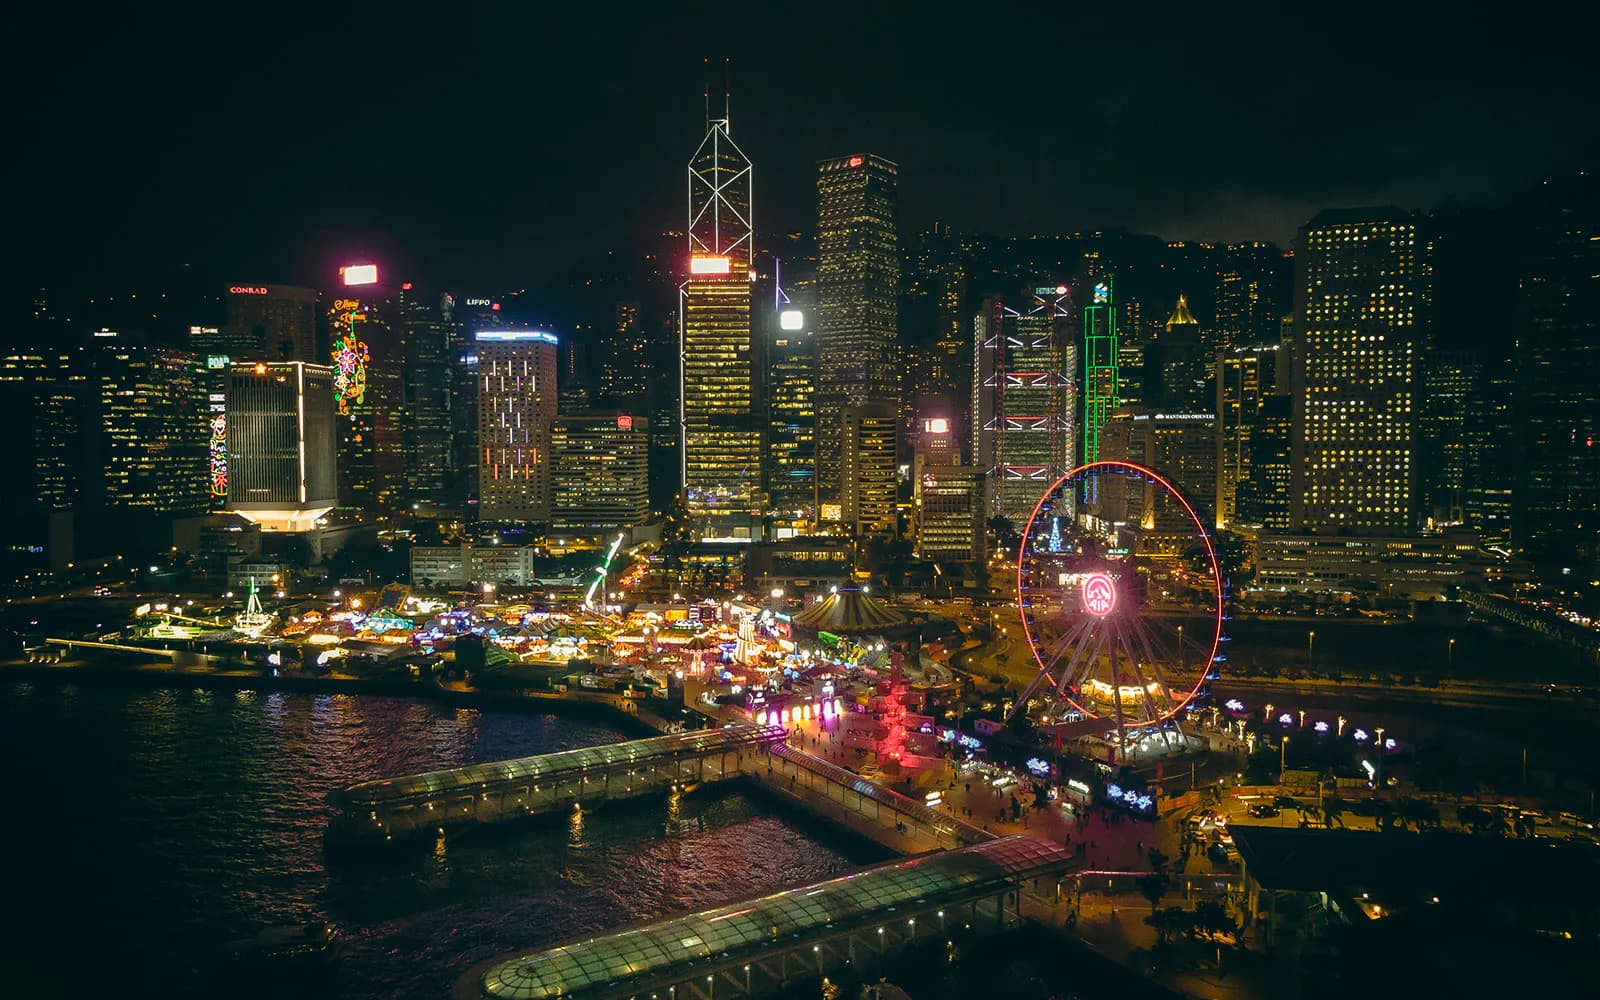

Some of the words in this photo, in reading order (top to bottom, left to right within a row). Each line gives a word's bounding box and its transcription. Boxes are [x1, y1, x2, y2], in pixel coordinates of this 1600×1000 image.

[230, 286, 268, 295] CONRAD
[466, 298, 490, 306] LIPPO
[1089, 599, 1110, 612] AIA
